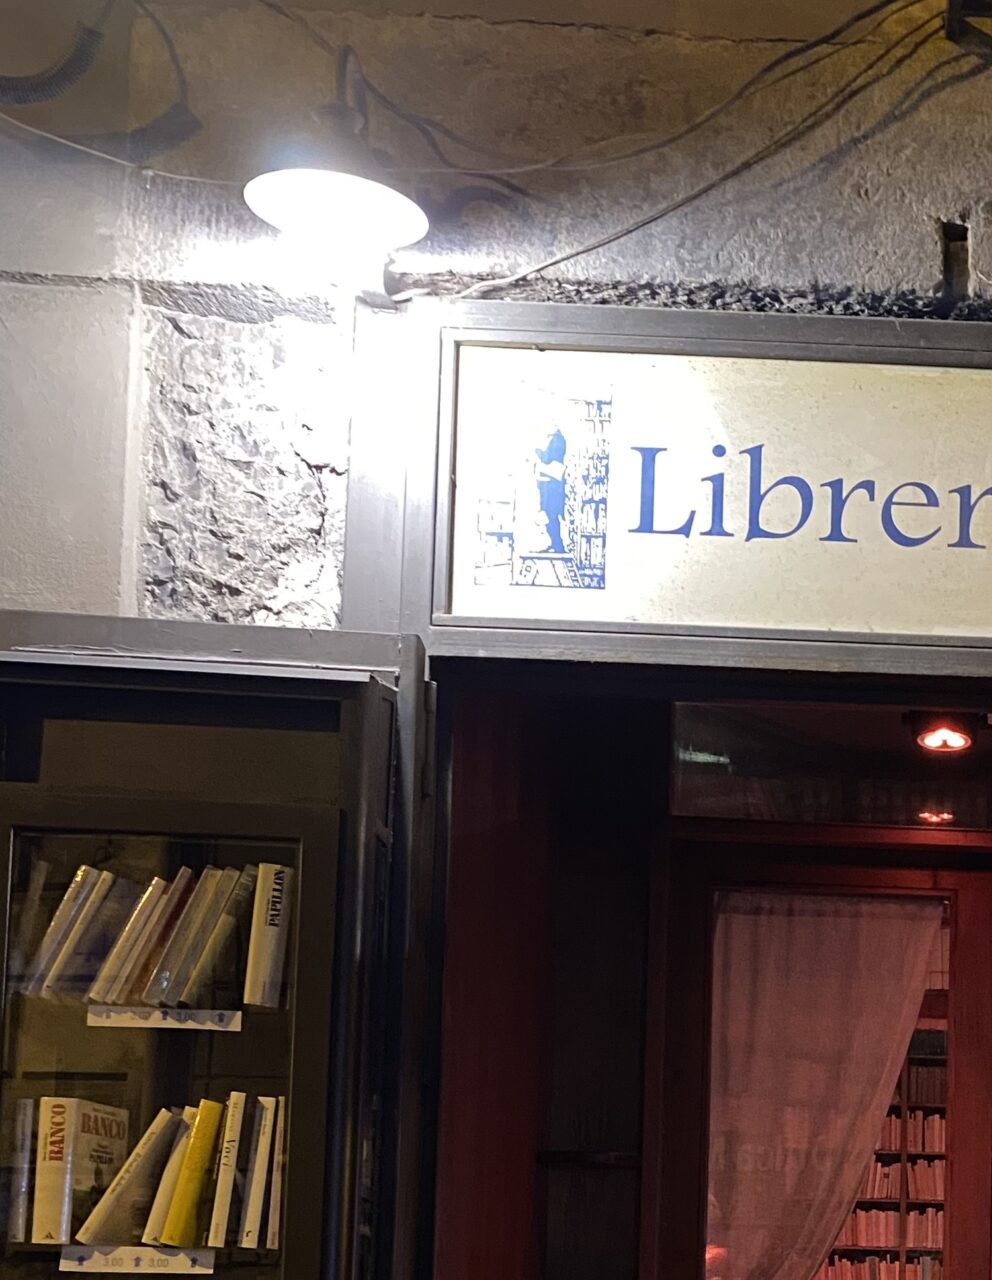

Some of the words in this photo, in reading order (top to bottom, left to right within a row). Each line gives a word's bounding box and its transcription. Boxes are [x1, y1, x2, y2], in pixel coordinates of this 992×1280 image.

[268, 869, 285, 928] PAPILLON
[48, 1103, 67, 1161] BANCO
[81, 1112, 126, 1140] BANCO
